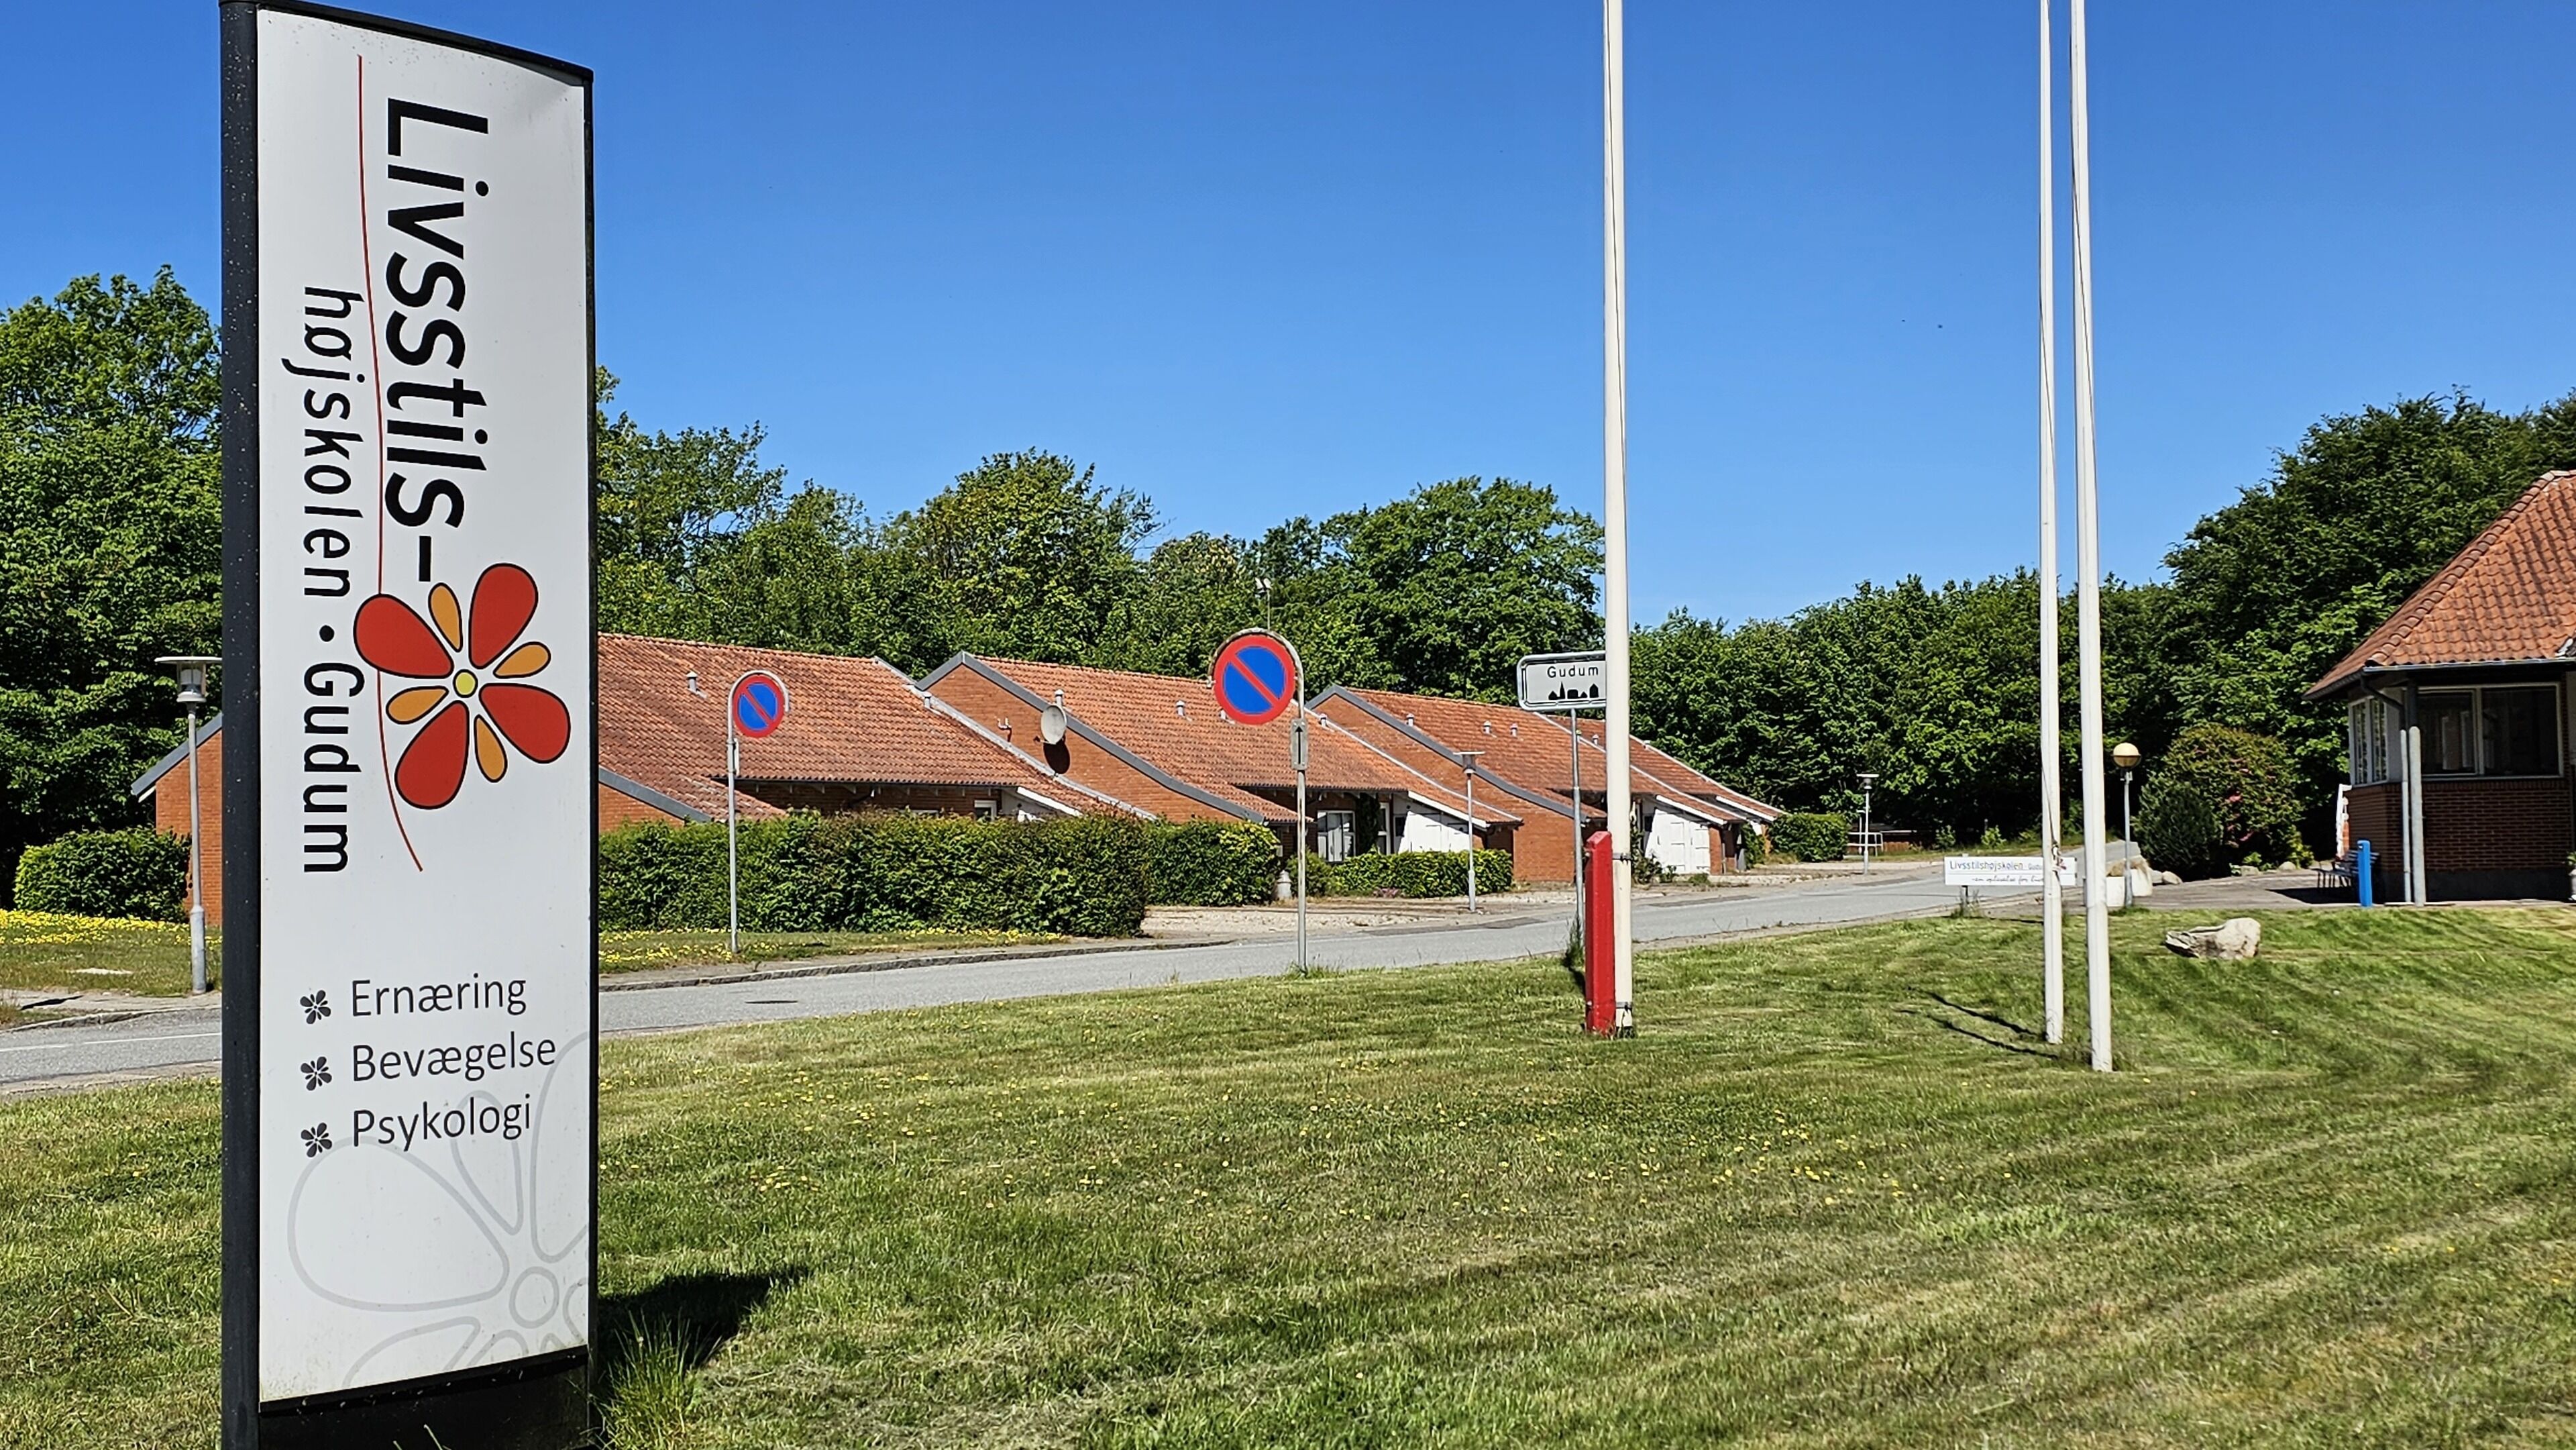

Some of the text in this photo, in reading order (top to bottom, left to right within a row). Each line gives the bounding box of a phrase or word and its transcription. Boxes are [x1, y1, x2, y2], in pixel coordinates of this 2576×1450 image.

[385, 97, 489, 582] Livsstils-
[282, 286, 365, 873] højskolen Gudum
[1547, 665, 1599, 678] Gudum
[352, 973, 527, 1016] Ernæring
[352, 1031, 556, 1082] Bevægelse
[353, 1093, 531, 1152] Psykologi
